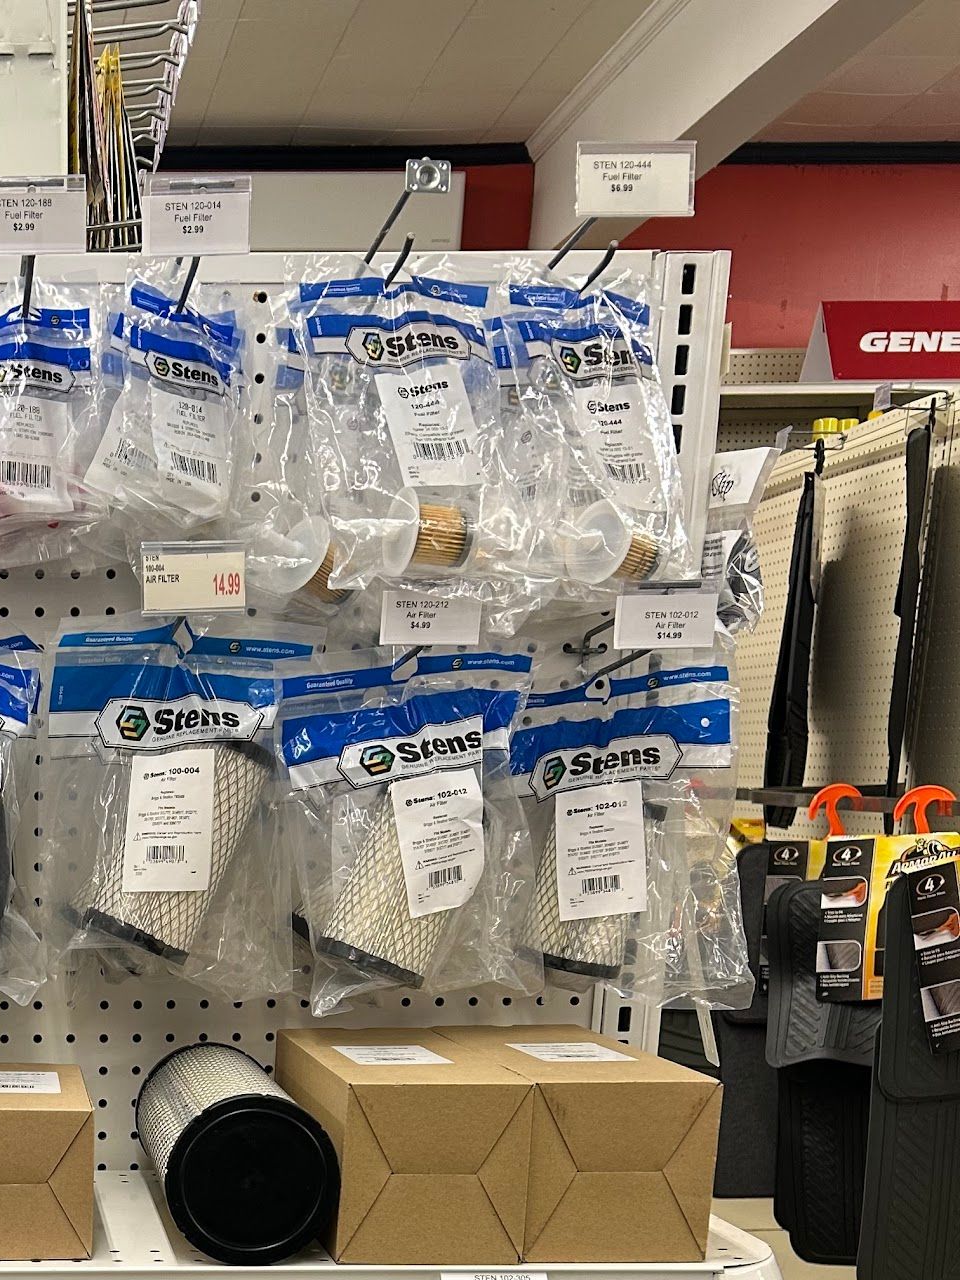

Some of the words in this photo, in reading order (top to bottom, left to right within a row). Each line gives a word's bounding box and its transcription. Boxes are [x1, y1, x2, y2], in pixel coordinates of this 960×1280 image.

[594, 161, 617, 170] STEN
[619, 160, 652, 170] 120-444
[602, 172, 620, 181] Fuel
[623, 172, 642, 181] Filter
[611, 184, 633, 192] $6.99
[21, 198, 52, 208] 120-188
[165, 202, 188, 210] STEN
[190, 201, 221, 210] 120-014
[5, 211, 22, 220] Fuel
[24, 210, 43, 220] Filter
[174, 214, 190, 222] Fuel
[193, 213, 212, 222] Filter
[13, 222, 34, 232] $2.99
[182, 225, 204, 234] $2.99
[386, 332, 459, 358] Stens
[859, 331, 960, 353] GENE
[584, 343, 634, 366] Sen
[10, 362, 63, 384] Stens
[172, 361, 219, 386] Stens
[410, 380, 449, 398] Stens
[597, 401, 631, 413] Stens
[146, 564, 166, 572] 100-004
[146, 575, 155, 584] AIR
[156, 574, 180, 584] FILTER
[213, 572, 240, 596] 14.99
[396, 600, 418, 609] STEN
[419, 600, 449, 609] 120-212
[406, 611, 416, 620] Air
[418, 611, 436, 620] Filter
[644, 611, 667, 620] STEN
[669, 610, 699, 620] 102-012
[410, 621, 430, 630] $4.99
[656, 621, 666, 630] Air
[668, 621, 686, 630] Filter
[657, 631, 682, 640] $14.99
[153, 708, 240, 736] Stens
[396, 731, 482, 763] Stens
[569, 746, 661, 776] Stens
[168, 766, 200, 776] 100-004
[436, 788, 468, 800] 102-012
